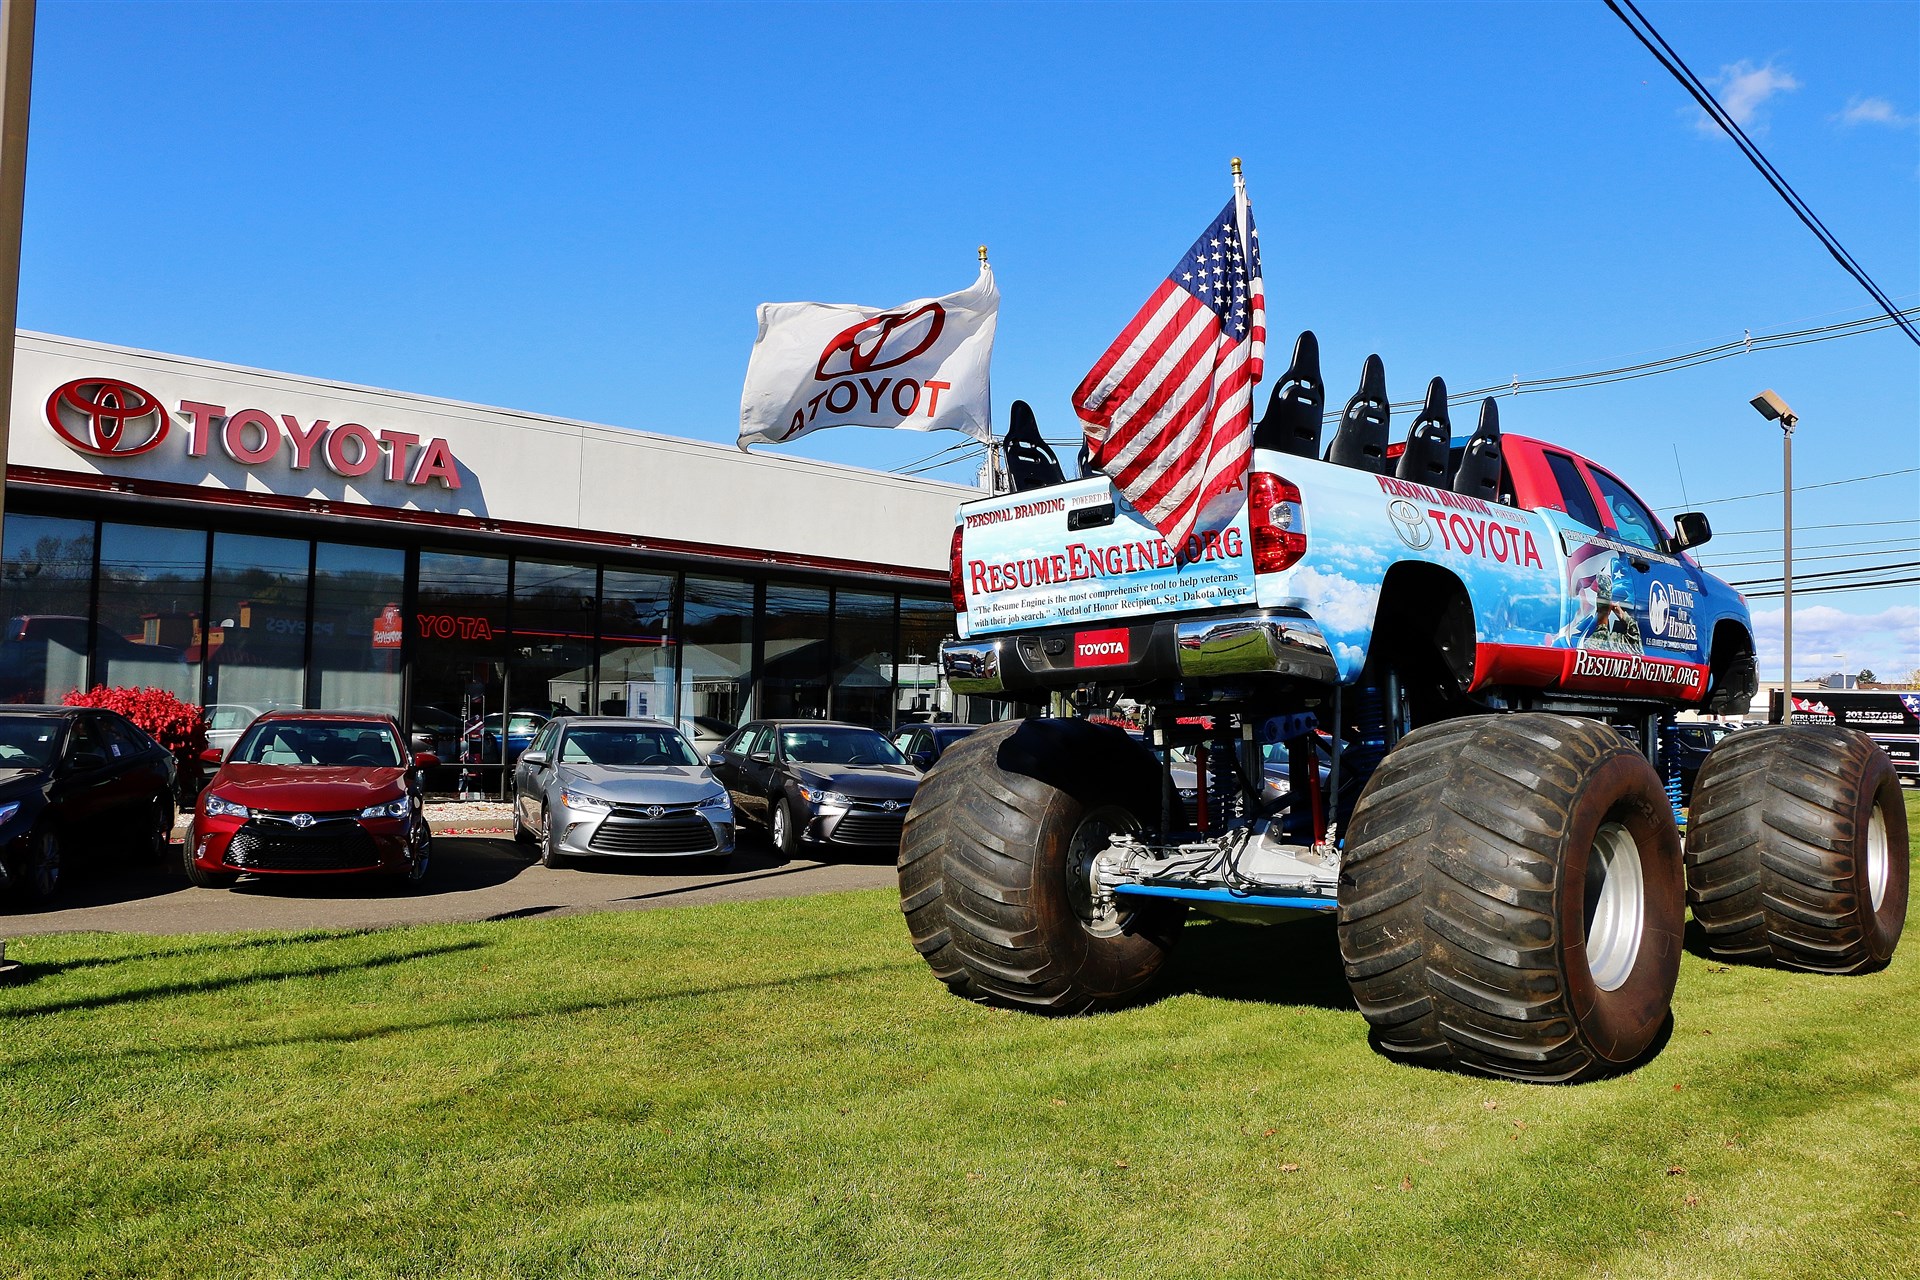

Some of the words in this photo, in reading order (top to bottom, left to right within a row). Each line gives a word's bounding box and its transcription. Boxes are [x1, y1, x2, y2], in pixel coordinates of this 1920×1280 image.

[175, 399, 462, 490] TOYOTA
[966, 509, 1013, 529] PERSONAL
[1014, 498, 1065, 521] BRANDING
[1072, 494, 1101, 507] POWERED
[1102, 492, 1112, 501] BY
[1375, 475, 1439, 505] PERSONAL
[1437, 489, 1493, 517] BRANDING
[1428, 509, 1543, 569] TOYOTA
[974, 618, 989, 628] with
[990, 616, 1007, 626] their
[1008, 614, 1020, 626] job
[1058, 605, 1081, 617] Medal
[1083, 603, 1092, 613] of
[1093, 602, 1118, 613] Honor
[1121, 596, 1162, 609] Recipient,
[1164, 594, 1180, 605] Sgt.
[1183, 589, 1215, 601] Dakota
[1217, 587, 1247, 598] Meyer
[993, 602, 1019, 612] Resume
[1021, 599, 1046, 609] Engine
[1047, 596, 1054, 605] is
[1055, 594, 1067, 604] the
[1069, 592, 1087, 602] most
[1089, 584, 1148, 600] comprehensive
[1150, 581, 1166, 590] tool
[1168, 579, 1177, 589] to
[1179, 577, 1198, 588] help
[1200, 574, 1238, 582] veterans
[1078, 642, 1124, 656] TOYOTA
